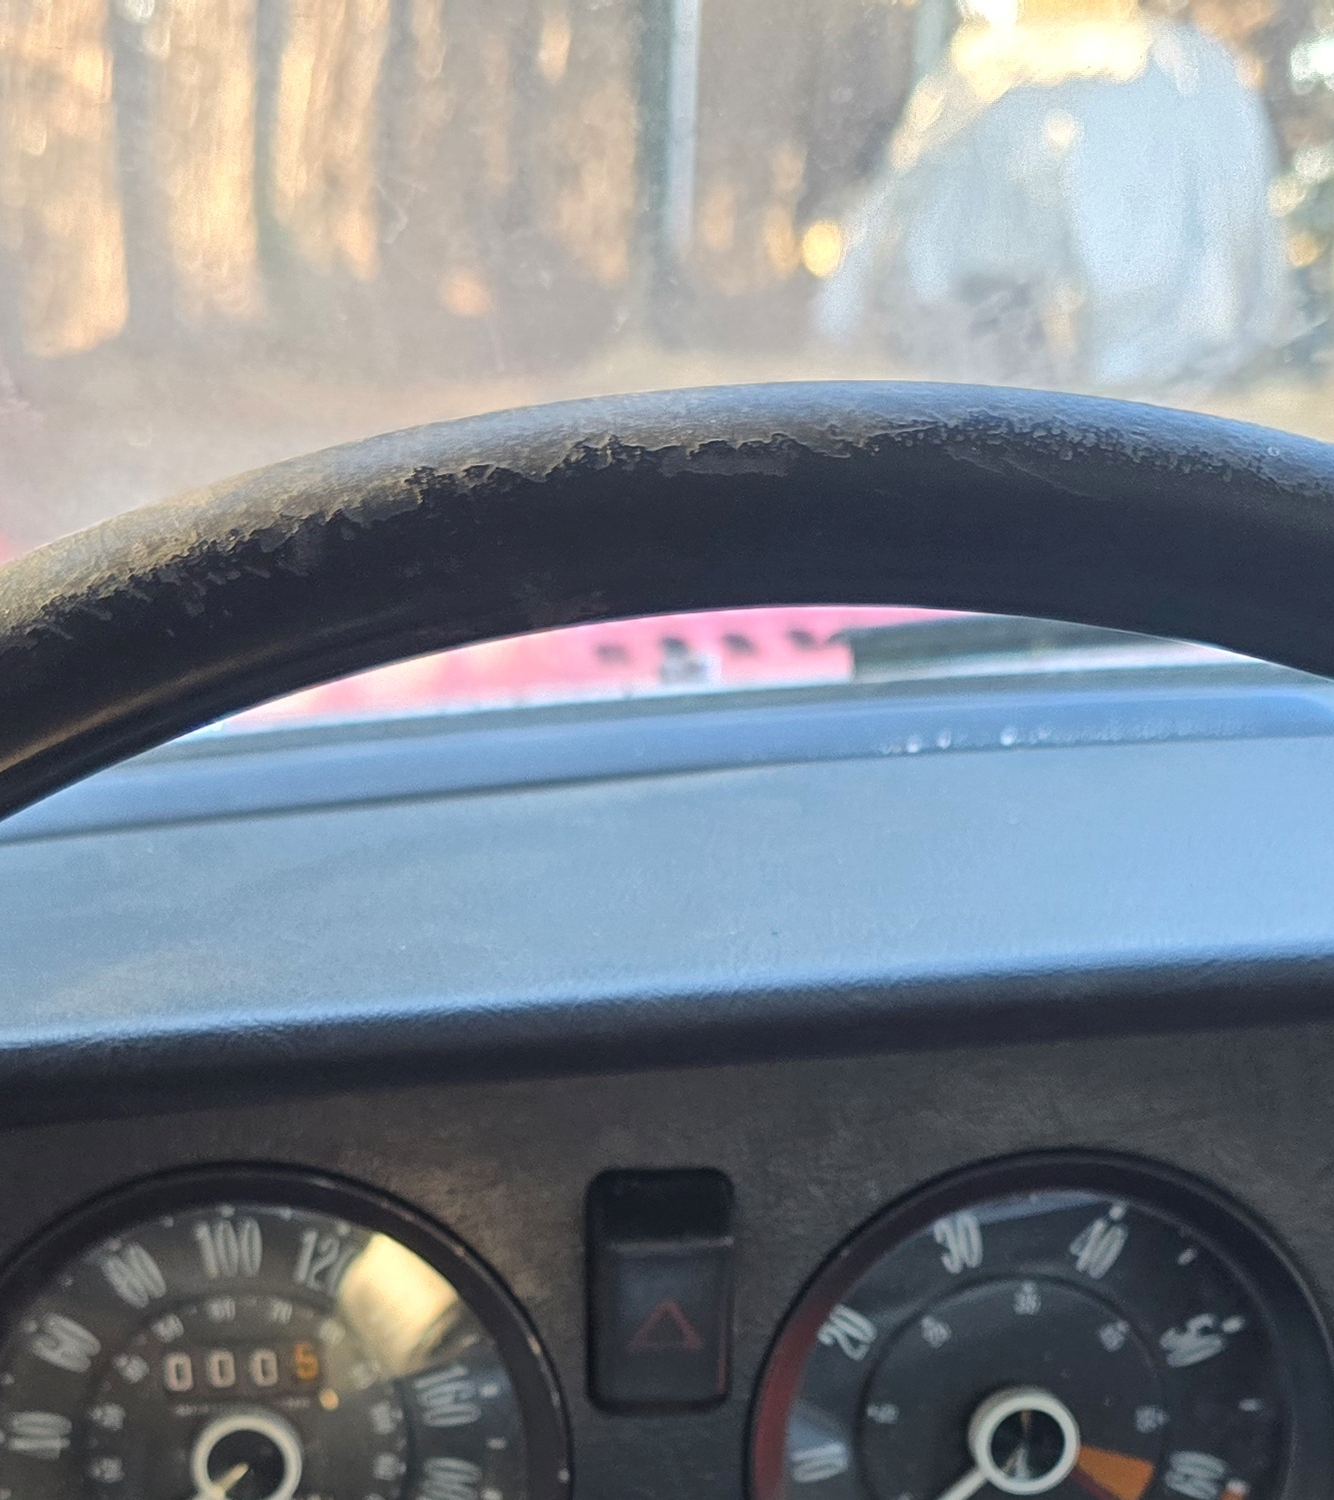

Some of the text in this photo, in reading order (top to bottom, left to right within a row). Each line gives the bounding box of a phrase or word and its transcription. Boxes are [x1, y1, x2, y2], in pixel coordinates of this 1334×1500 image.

[194, 1216, 263, 1279] 100
[933, 1209, 983, 1275] 30
[1069, 1218, 1128, 1280] 40
[817, 1303, 878, 1362] 20
